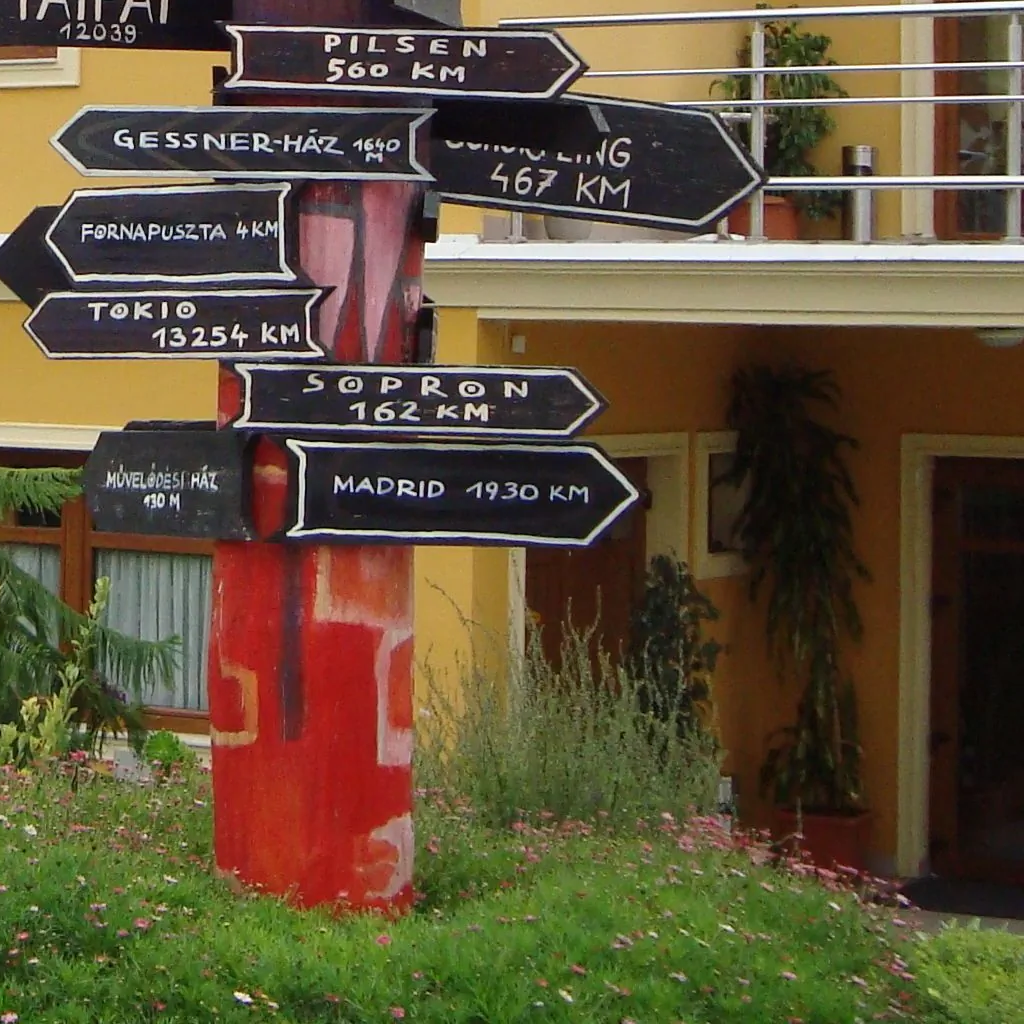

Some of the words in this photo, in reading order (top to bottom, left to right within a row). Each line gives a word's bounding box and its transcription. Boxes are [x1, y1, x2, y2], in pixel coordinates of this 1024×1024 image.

[60, 24, 137, 43] 12039
[324, 34, 487, 57] PILSEN
[326, 58, 389, 83] 560
[411, 61, 466, 83] KM
[113, 128, 345, 155] GESSNER-HÁZ
[352, 137, 401, 154] 1640
[365, 152, 384, 163] M
[489, 162, 558, 198] 467
[575, 172, 631, 209] KM
[81, 222, 227, 242] FORNAPUSZTA
[88, 301, 197, 321] TOKIO
[151, 323, 249, 348] 13254
[261, 321, 300, 345] KM
[302, 374, 528, 398] SOPRON
[350, 401, 421, 422] 162
[436, 402, 489, 422] KM
[334, 475, 445, 498] MADRID
[466, 481, 539, 501] 1930
[549, 485, 589, 504] KM
[143, 492, 166, 509] 130
[169, 492, 180, 511] M
